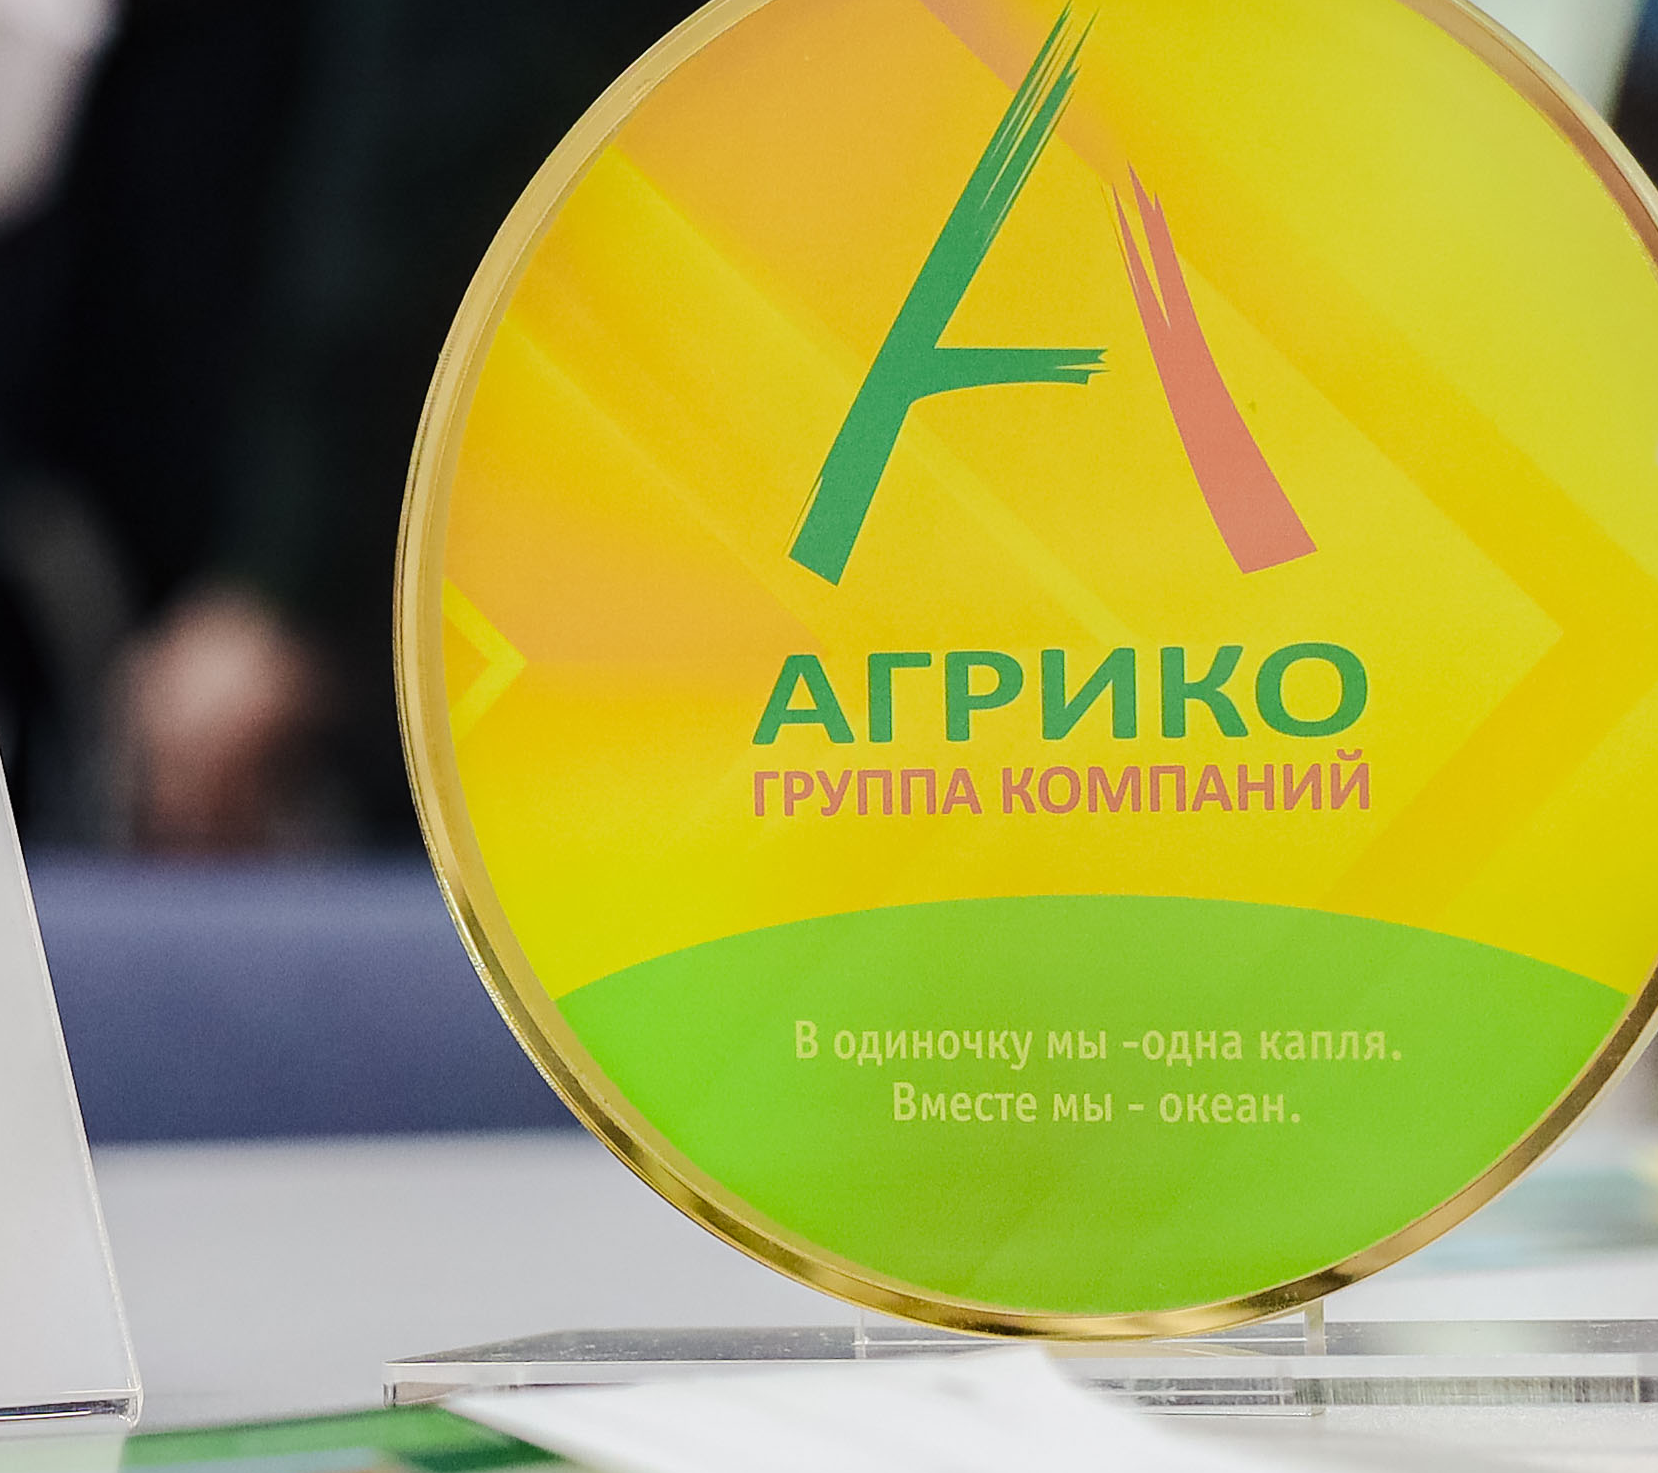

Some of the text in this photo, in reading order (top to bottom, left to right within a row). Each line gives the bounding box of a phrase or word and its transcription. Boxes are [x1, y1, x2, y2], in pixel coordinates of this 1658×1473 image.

[752, 642, 1368, 745] АГРИКО
[754, 748, 1371, 817] ГРУППА КОМПАНИЙ
[794, 1019, 819, 1060] В
[833, 1028, 1033, 1071] одиночку
[1047, 1029, 1107, 1060] мы
[1260, 1030, 1402, 1062] капля.
[892, 1081, 1038, 1124] Вместе
[1052, 1092, 1113, 1123] мы
[1159, 1092, 1302, 1124] океан.
